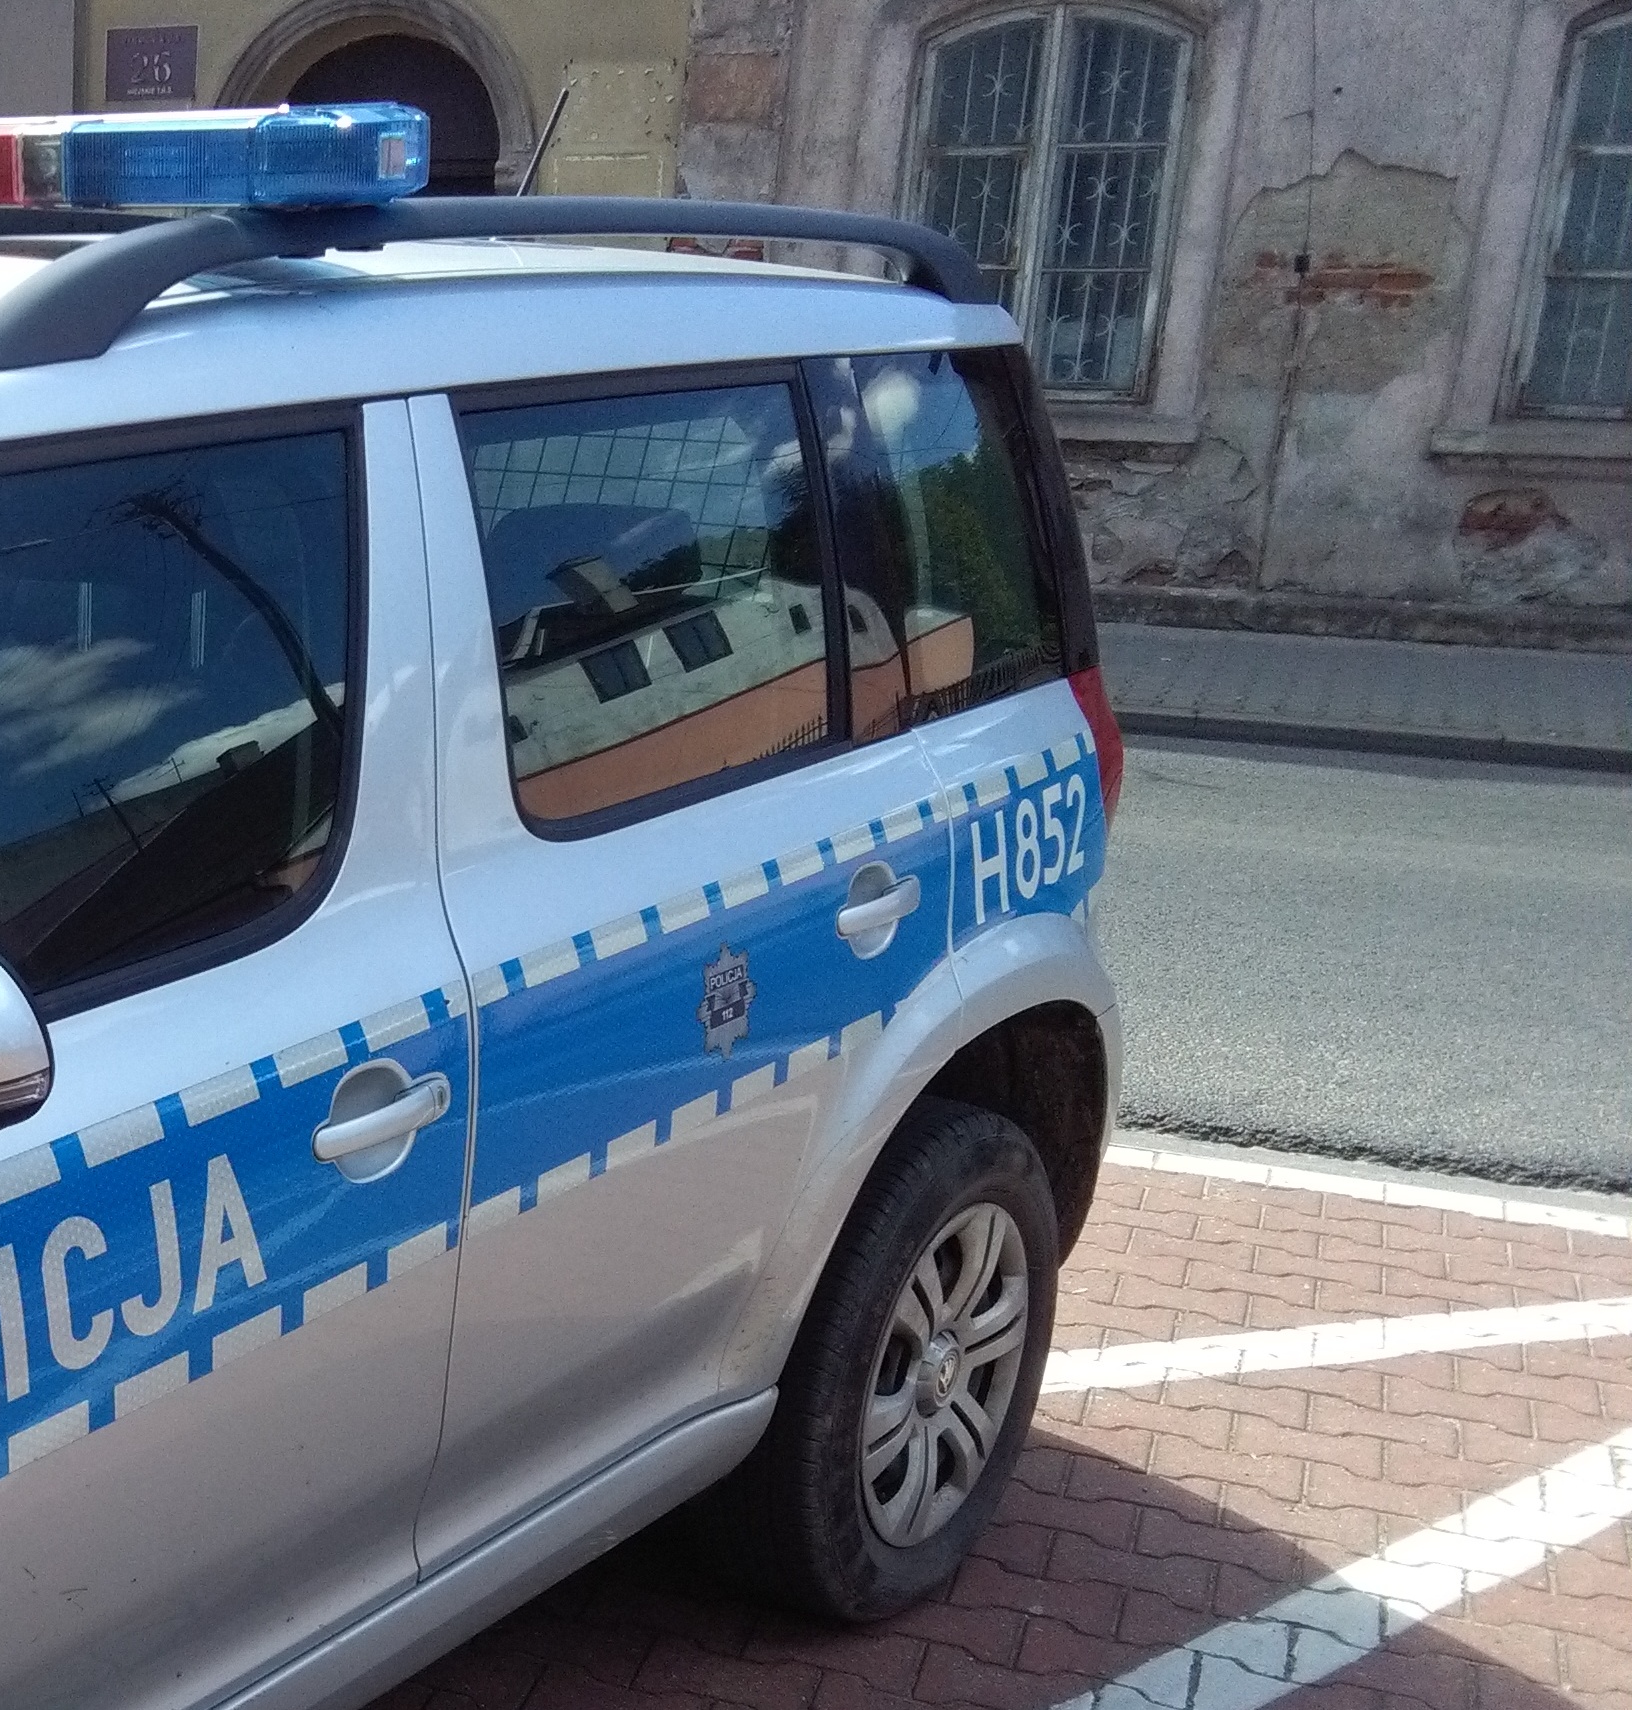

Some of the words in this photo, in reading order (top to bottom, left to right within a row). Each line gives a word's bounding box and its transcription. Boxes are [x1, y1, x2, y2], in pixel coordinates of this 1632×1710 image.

[130, 51, 171, 82] 26
[970, 774, 1086, 925] H852
[710, 966, 743, 989] POLICJA
[721, 1007, 734, 1021] 112
